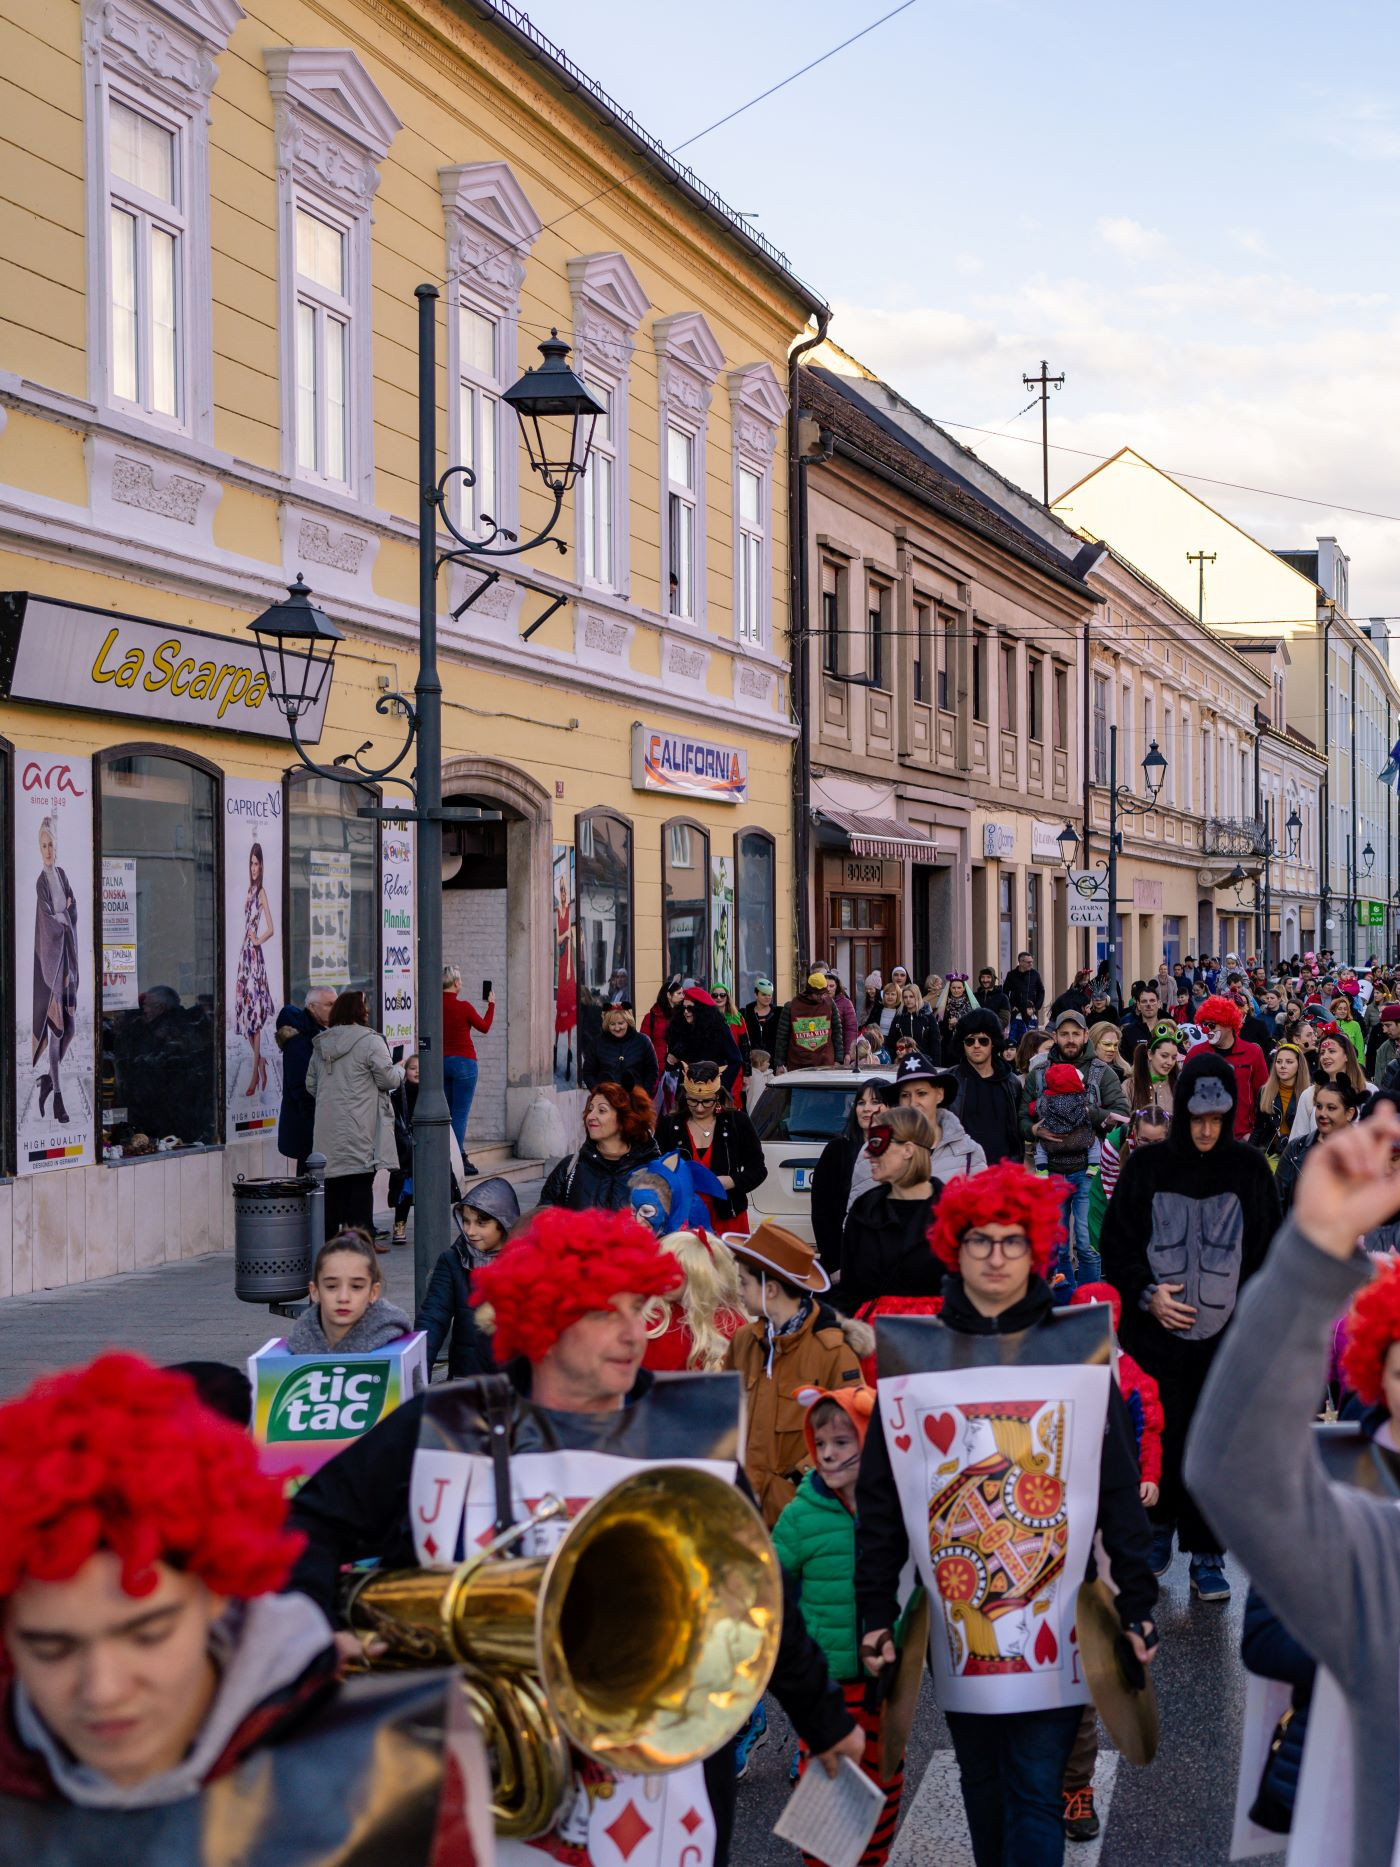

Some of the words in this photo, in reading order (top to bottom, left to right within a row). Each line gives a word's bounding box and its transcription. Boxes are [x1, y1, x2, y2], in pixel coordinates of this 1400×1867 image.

[91, 627, 145, 688] La
[143, 639, 271, 718] Scarpa
[649, 735, 740, 782] CALIFORNIA
[22, 762, 85, 797] ara
[31, 796, 49, 806] since
[51, 796, 66, 807] 1949
[227, 798, 269, 818] CAPRICE
[847, 863, 880, 882] BOLERO
[384, 873, 409, 900] Relax
[1070, 912, 1103, 922] GALA
[386, 1024, 395, 1038] Dr.
[397, 1023, 412, 1036] Feet
[232, 1112, 248, 1122] HIGH
[252, 1108, 280, 1119] QUALITY
[24, 1140, 45, 1151] HIGH
[50, 1134, 87, 1147] QUALITY
[33, 1160, 54, 1170] DESIGNED
[307, 1366, 375, 1402] tic
[286, 1399, 369, 1431] tac
[890, 1396, 905, 1430] J
[419, 1479, 451, 1525] J
